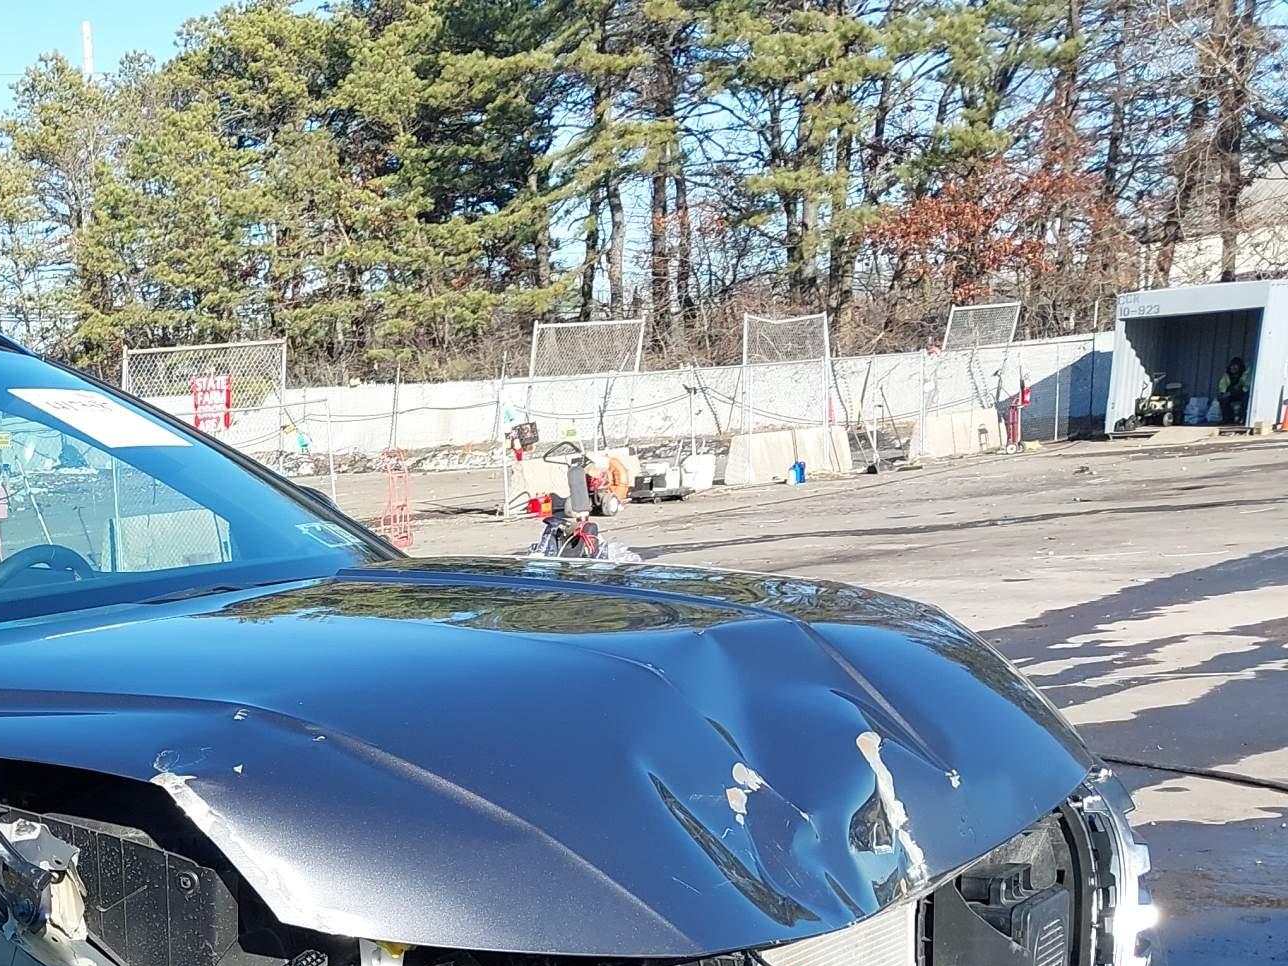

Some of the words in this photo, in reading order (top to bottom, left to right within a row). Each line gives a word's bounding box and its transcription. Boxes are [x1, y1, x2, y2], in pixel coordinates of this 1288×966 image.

[196, 377, 228, 391] STATE
[197, 391, 226, 405] FARM
[198, 418, 224, 432] AREA
